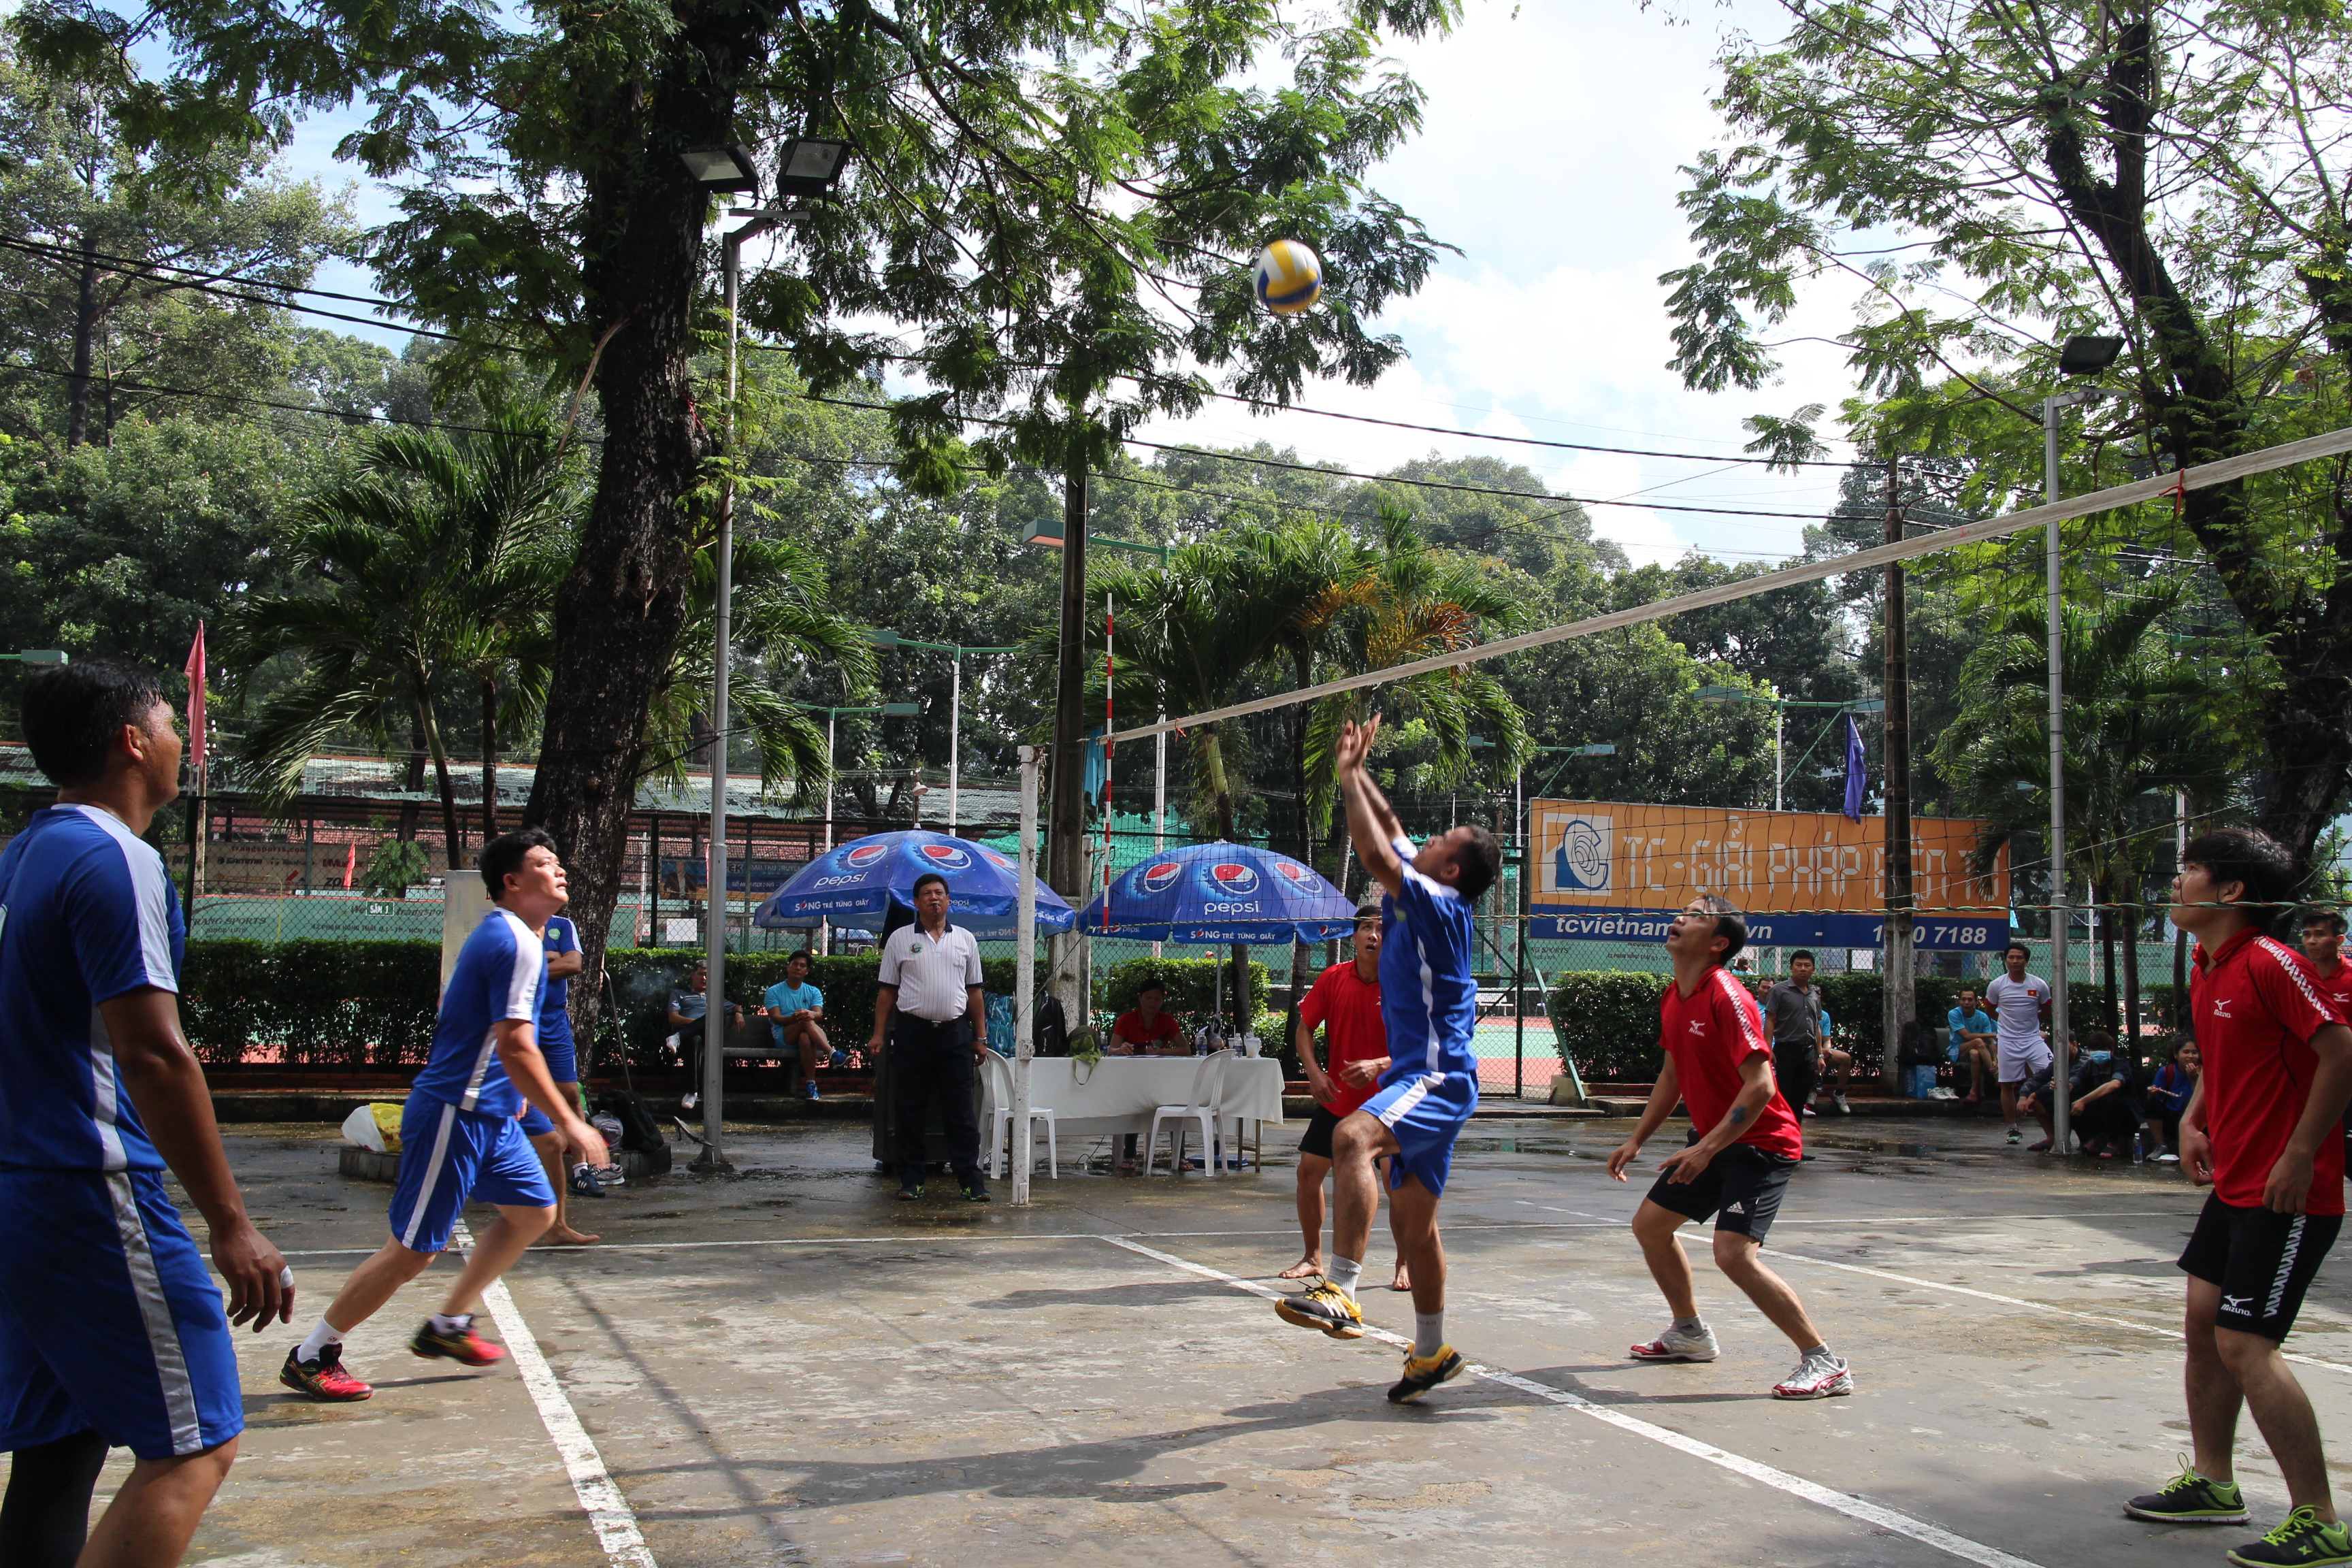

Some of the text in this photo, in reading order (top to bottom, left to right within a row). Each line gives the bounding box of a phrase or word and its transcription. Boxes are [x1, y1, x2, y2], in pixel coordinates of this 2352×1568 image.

[1769, 831, 1861, 896] PHÁP
[813, 872, 868, 889] pepsi
[855, 898, 869, 906] GIÂY
[1205, 900, 1259, 915] pepsi
[225, 917, 267, 926] SPORTS
[1873, 925, 1926, 943] 10
[1934, 926, 1987, 944] 7188
[2047, 1053, 2054, 1061] 6
